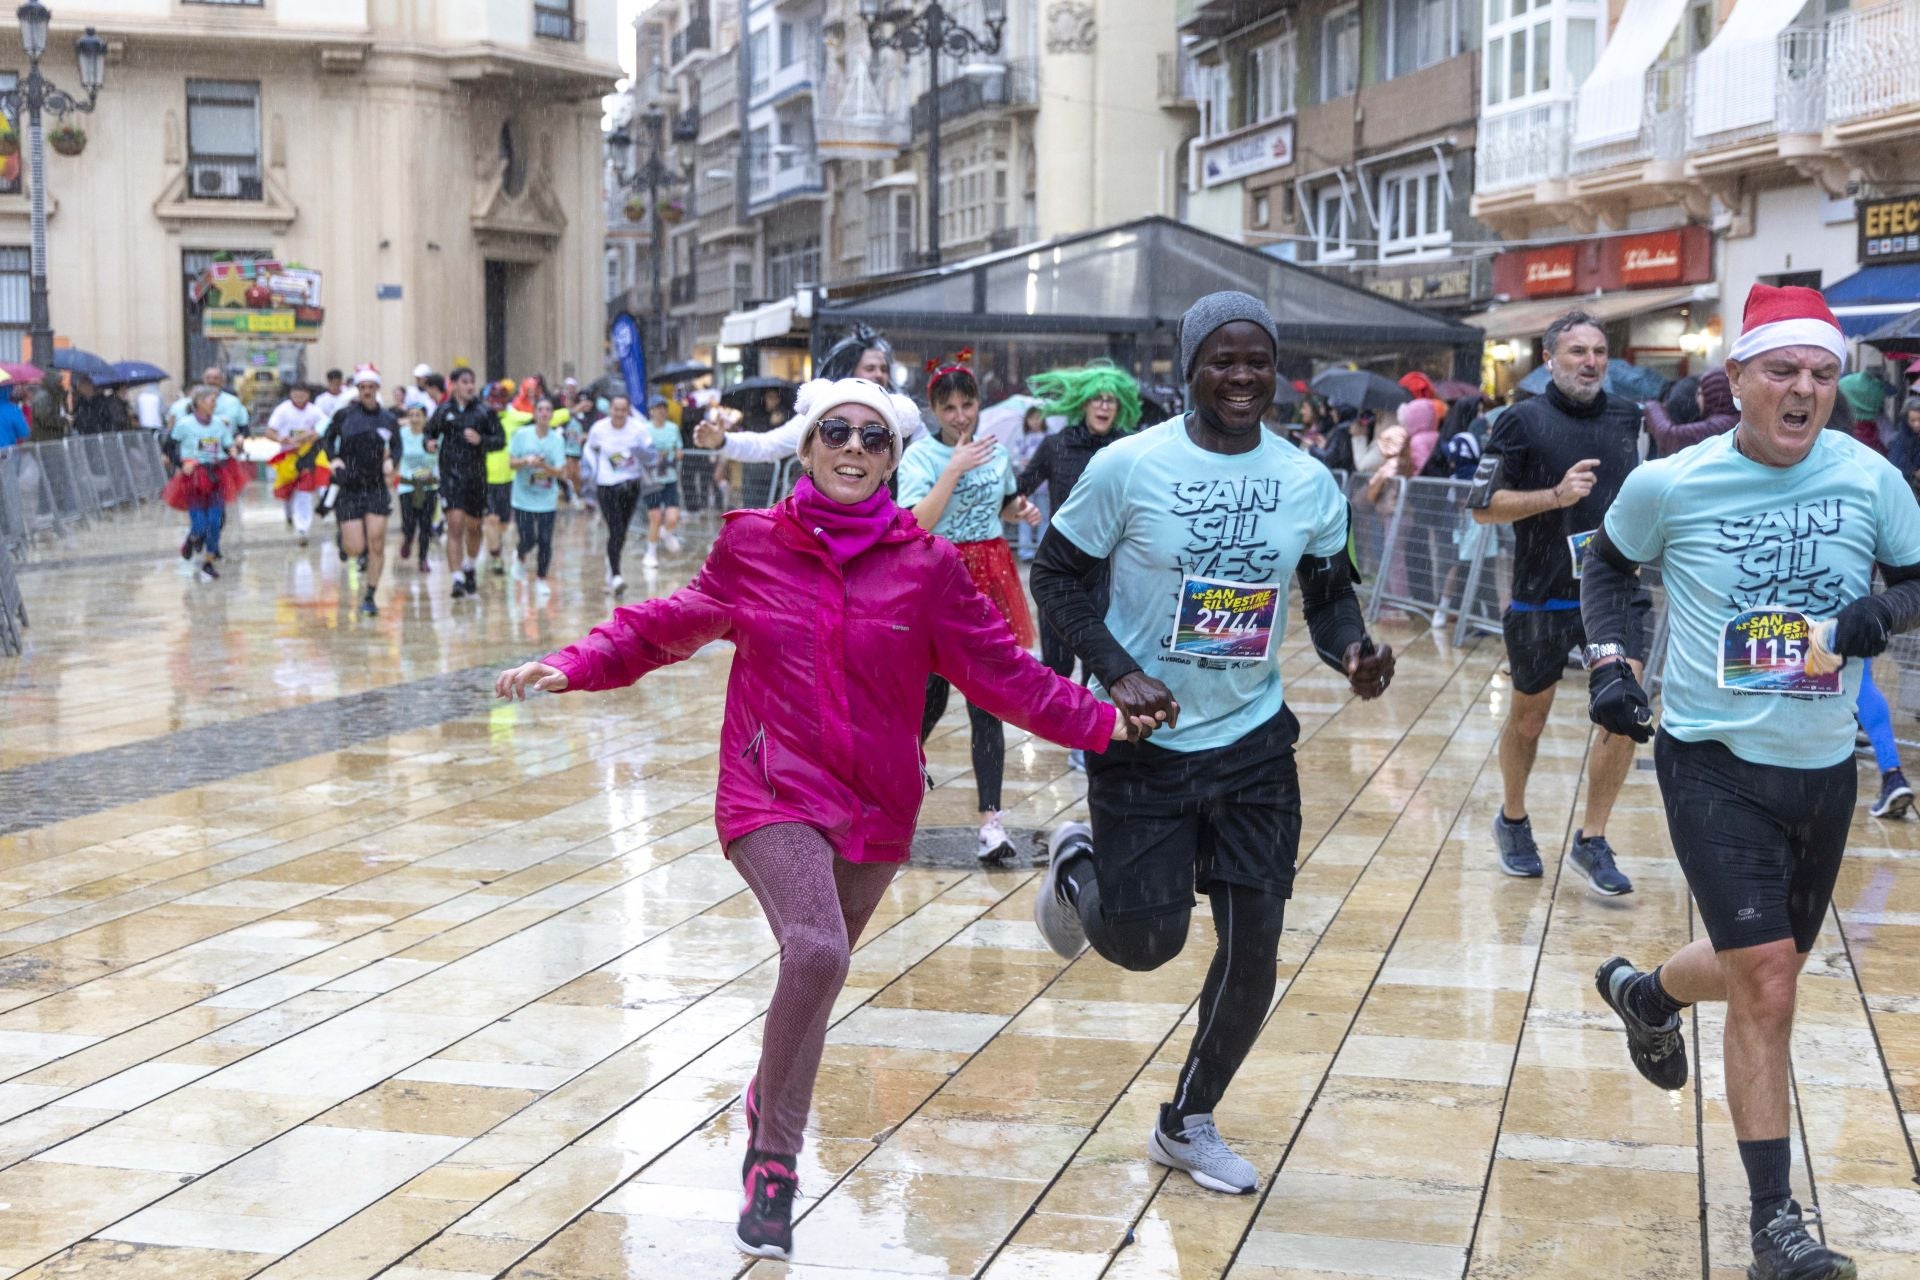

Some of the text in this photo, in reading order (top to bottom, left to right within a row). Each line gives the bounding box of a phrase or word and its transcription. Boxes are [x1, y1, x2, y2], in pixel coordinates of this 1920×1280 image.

[1170, 477, 1280, 517] SAN
[1183, 514, 1267, 554] SIL
[1717, 498, 1843, 553] SAN
[1732, 540, 1831, 592] SIL
[1203, 590, 1271, 610] SILVESTRE
[1204, 588, 1236, 601] SAN
[1195, 608, 1258, 637] 2744
[1749, 614, 1783, 628] SAN
[1165, 656, 1191, 665] VERDAD
[1745, 638, 1801, 667] 115
